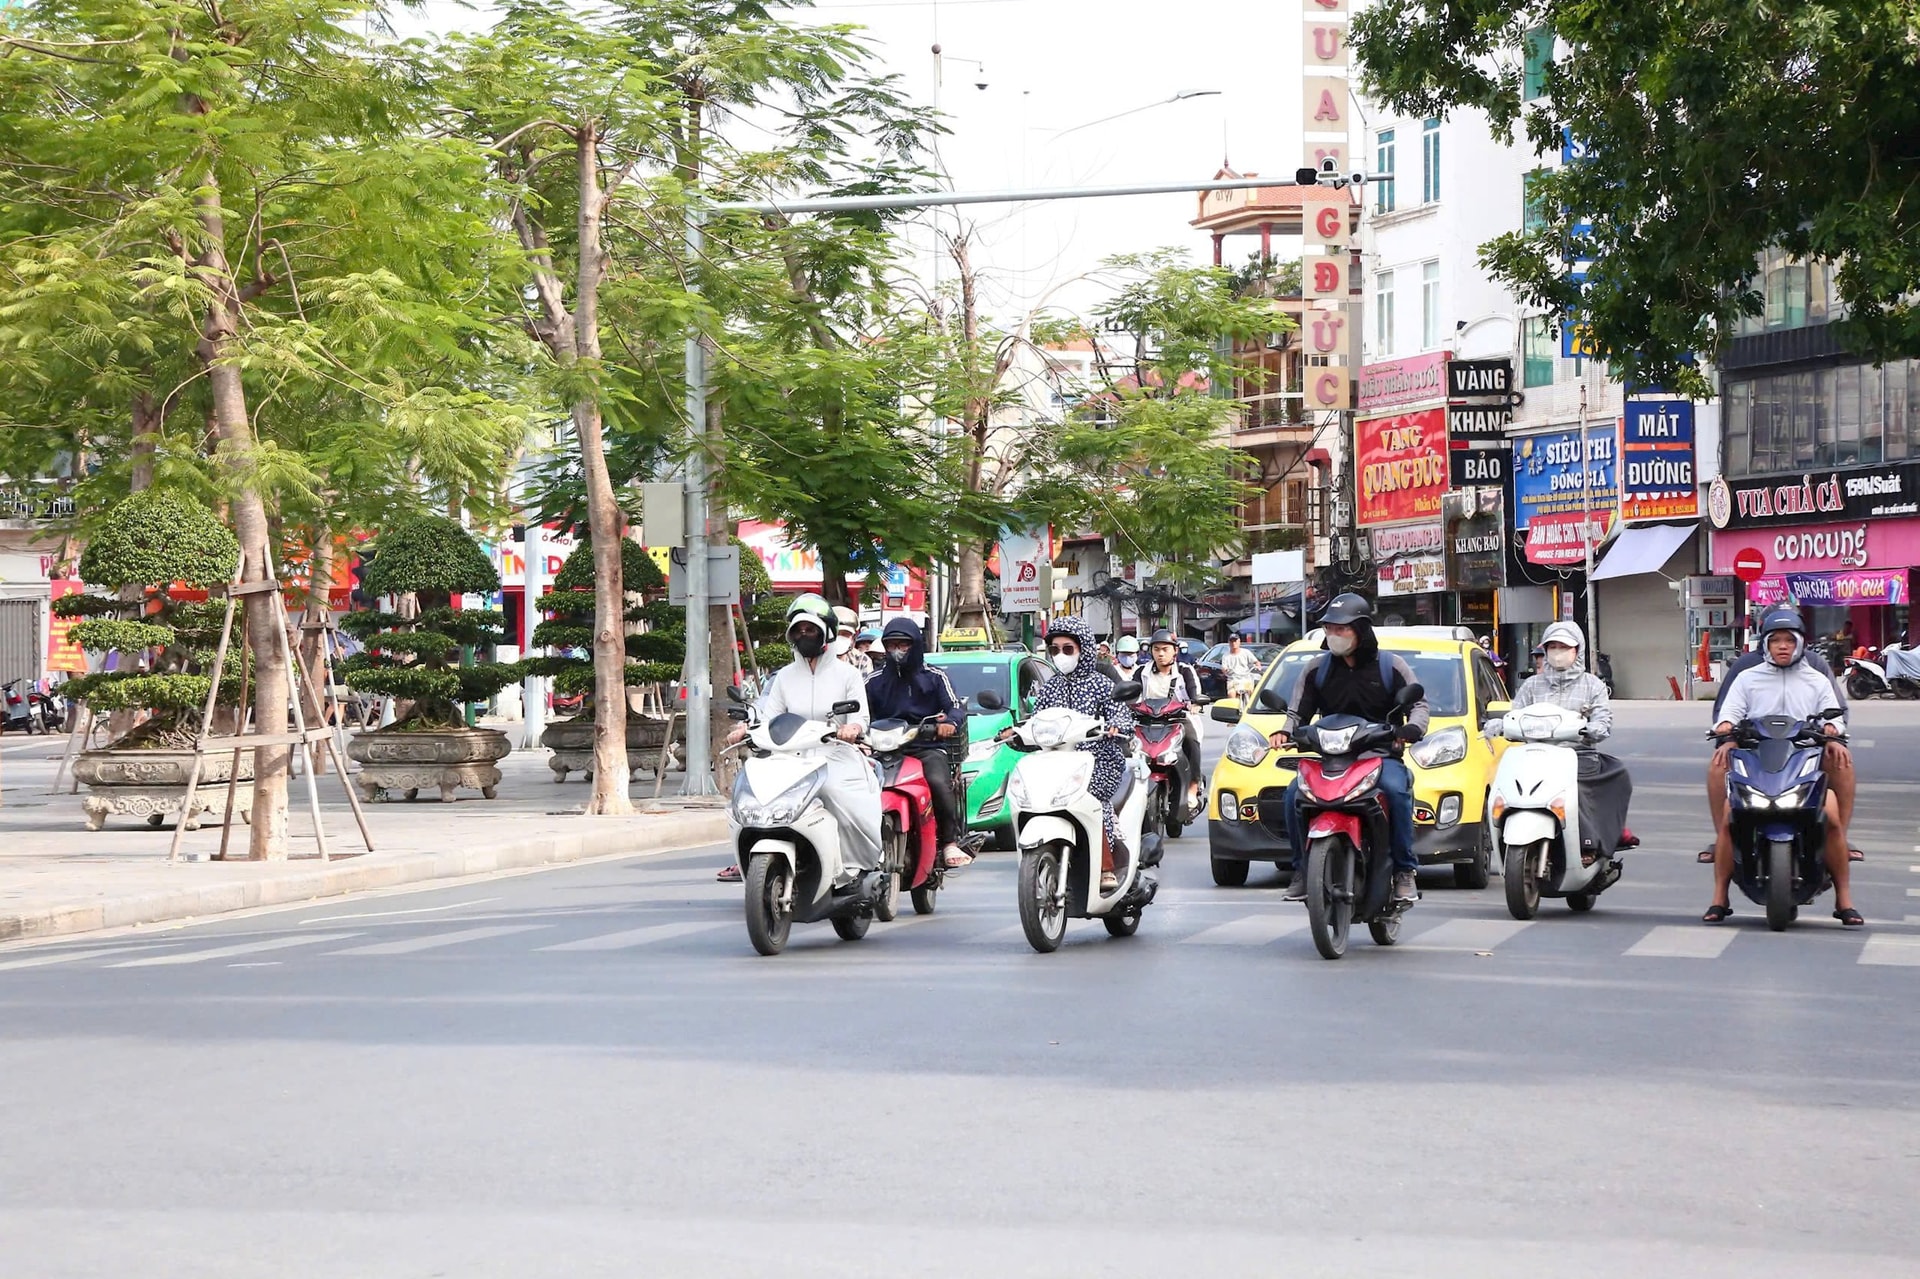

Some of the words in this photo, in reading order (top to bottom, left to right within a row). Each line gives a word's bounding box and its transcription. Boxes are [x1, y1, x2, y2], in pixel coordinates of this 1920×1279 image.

[1312, 0, 1341, 238] UAG
[1312, 262, 1344, 404] ĐỨC
[1456, 366, 1506, 391] VÀNG
[1451, 410, 1512, 432] KHANG
[1639, 405, 1680, 437] MẮT
[1380, 422, 1424, 451] VÀNG
[1546, 435, 1581, 465] SIÊU
[1363, 459, 1414, 501] QUANG
[1412, 447, 1445, 488] ĐỨC
[1465, 451, 1501, 479] BẢO
[1550, 464, 1583, 491] ĐỒNG
[1628, 457, 1692, 486] ĐƯỜNG
[1736, 486, 1773, 518] VUA
[1774, 474, 1815, 515] CHẢ
[1816, 473, 1844, 511] CÁ
[1455, 535, 1482, 553] KHANG
[1484, 531, 1499, 552] BẢO
[1530, 521, 1546, 544] BÁN
[1546, 519, 1563, 548] HOẶC
[1562, 522, 1576, 543] CHO
[1773, 523, 1868, 566] concung
